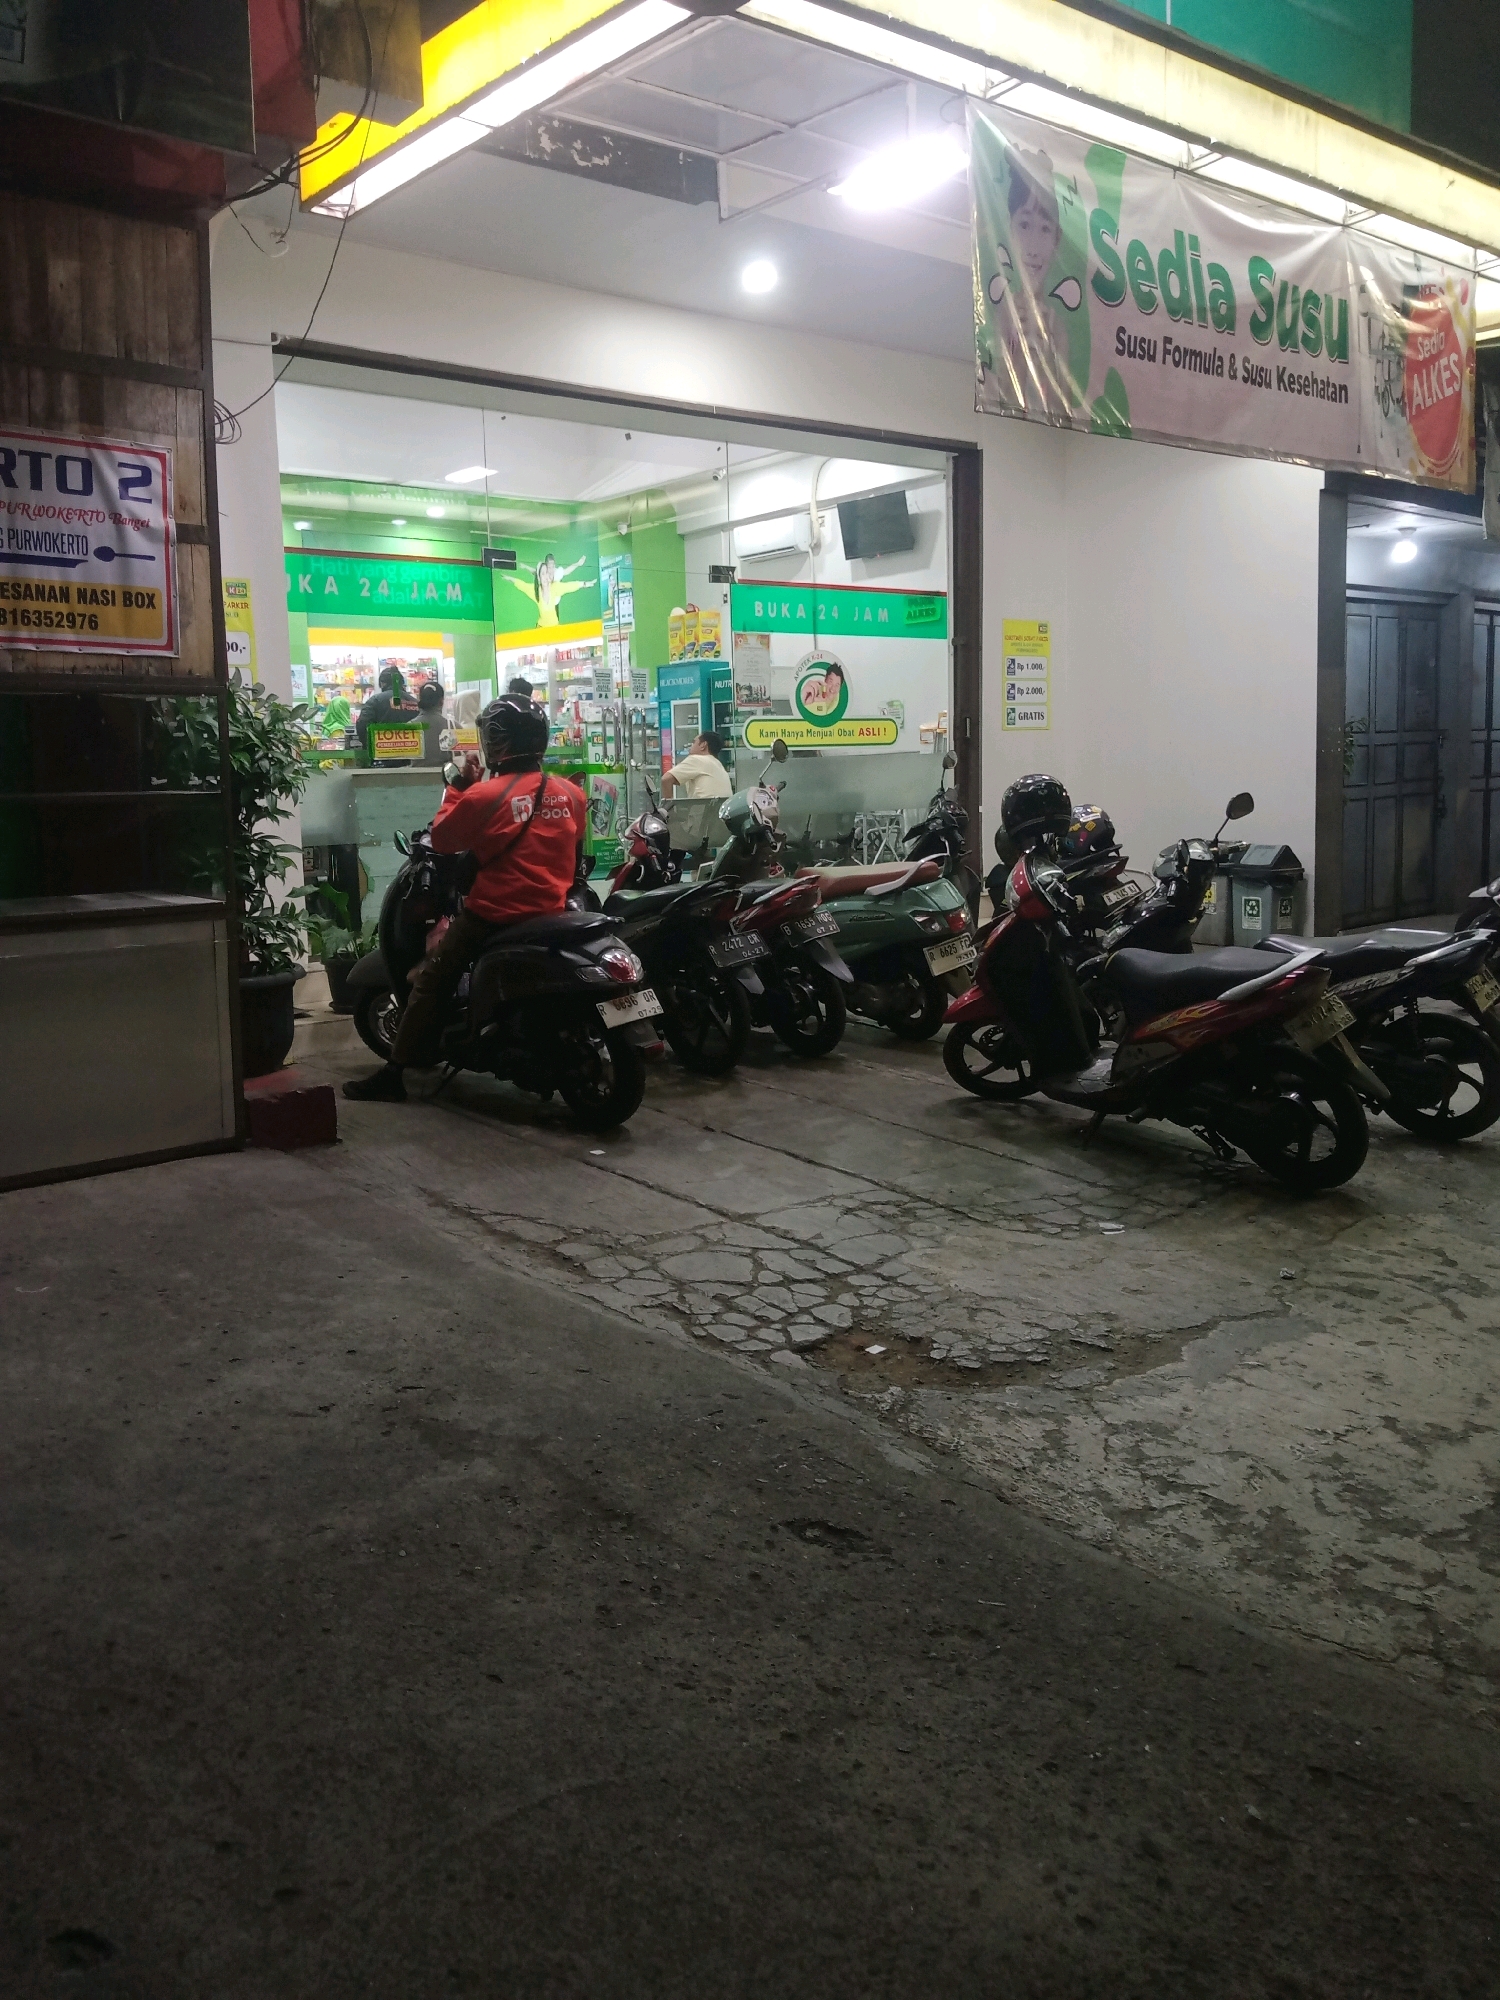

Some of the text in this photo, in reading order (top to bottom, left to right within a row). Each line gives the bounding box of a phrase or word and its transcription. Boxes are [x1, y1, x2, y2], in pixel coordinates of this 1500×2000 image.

[1089, 207, 1349, 364] Sedia Susu
[1115, 325, 1349, 404] Susu Formula & Susu Kesehatan
[1412, 352, 1462, 415] ALKES
[117, 462, 152, 504] 2
[7, 528, 89, 556] PURWOKERTO
[76, 587, 116, 607] NASI
[122, 591, 156, 610] BOX
[359, 577, 390, 597] 24
[411, 581, 462, 602] JAM
[754, 600, 889, 622] BUKA 24 JAM
[794, 658, 812, 681] APOTEK
[1018, 711, 1045, 721] GRATIS
[377, 729, 416, 741] LOKET
[759, 728, 779, 738] Kami
[781, 728, 804, 739] Hanya
[806, 728, 835, 740] Menjual
[837, 728, 855, 737] Obat
[858, 727, 881, 737] ASLI
[783, 925, 792, 936] B
[708, 945, 718, 956] R
[598, 1004, 608, 1017] R
